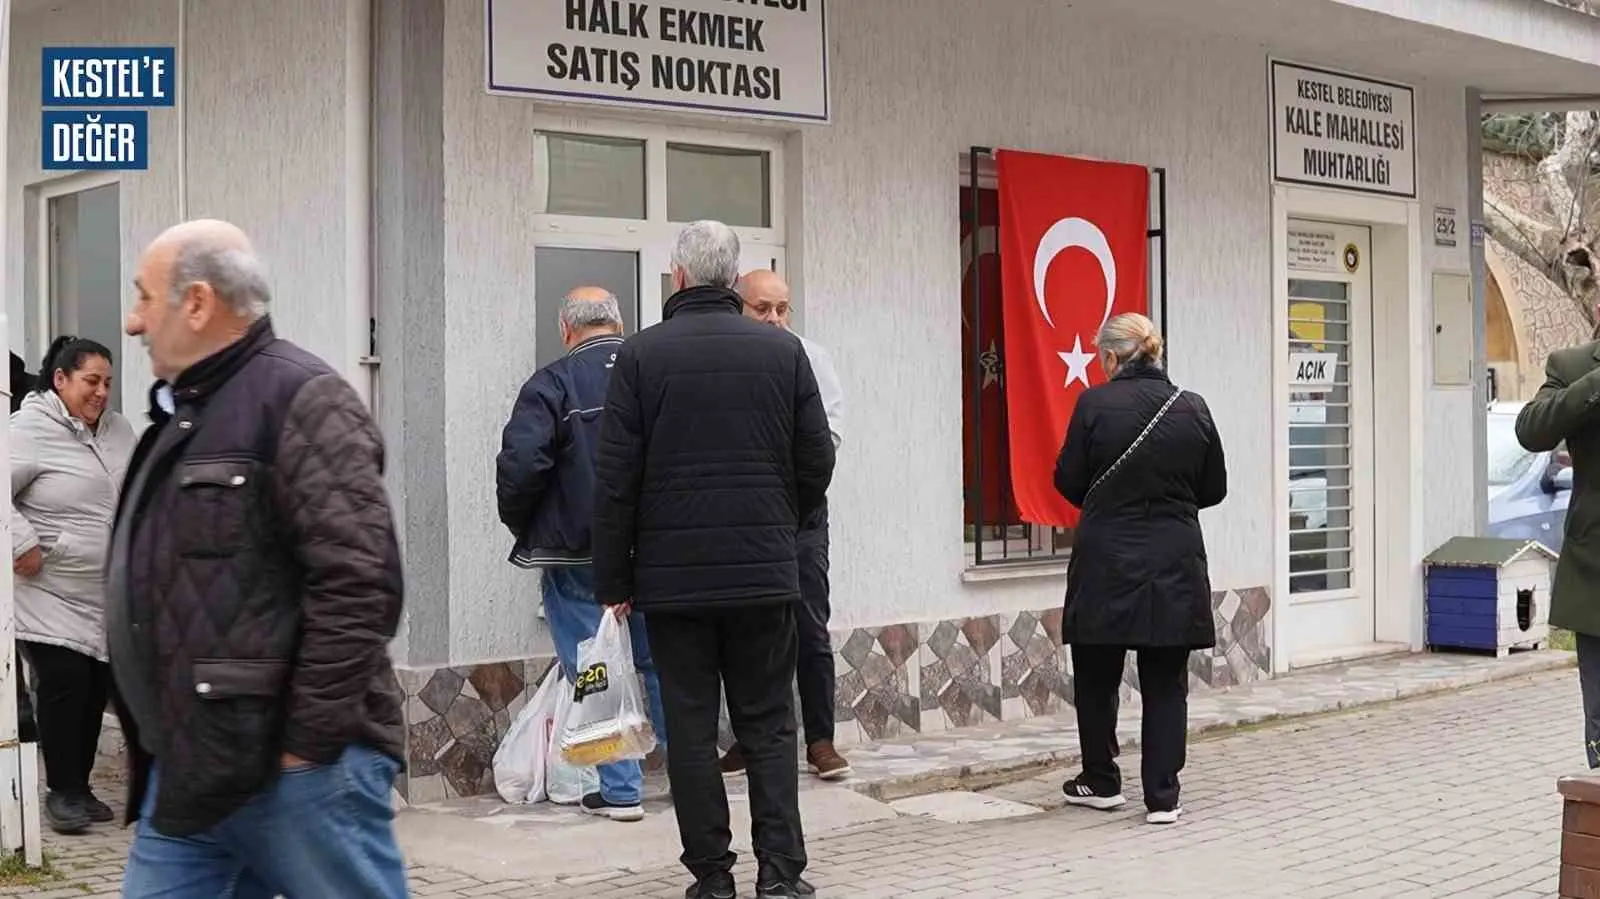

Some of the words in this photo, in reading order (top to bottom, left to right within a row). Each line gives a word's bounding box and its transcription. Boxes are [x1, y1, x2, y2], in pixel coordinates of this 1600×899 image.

[565, 0, 649, 38] HALK
[659, 7, 765, 52] EKMEK
[546, 43, 641, 91] SATIŞ
[651, 54, 782, 101] NOKTASI
[1297, 79, 1335, 104] KESTEL
[1337, 85, 1393, 114] BELEDİYESİ
[1285, 105, 1323, 139] KALE
[1326, 112, 1405, 150] MAHALLESİ
[1303, 147, 1391, 186] MUHTARLIĞI
